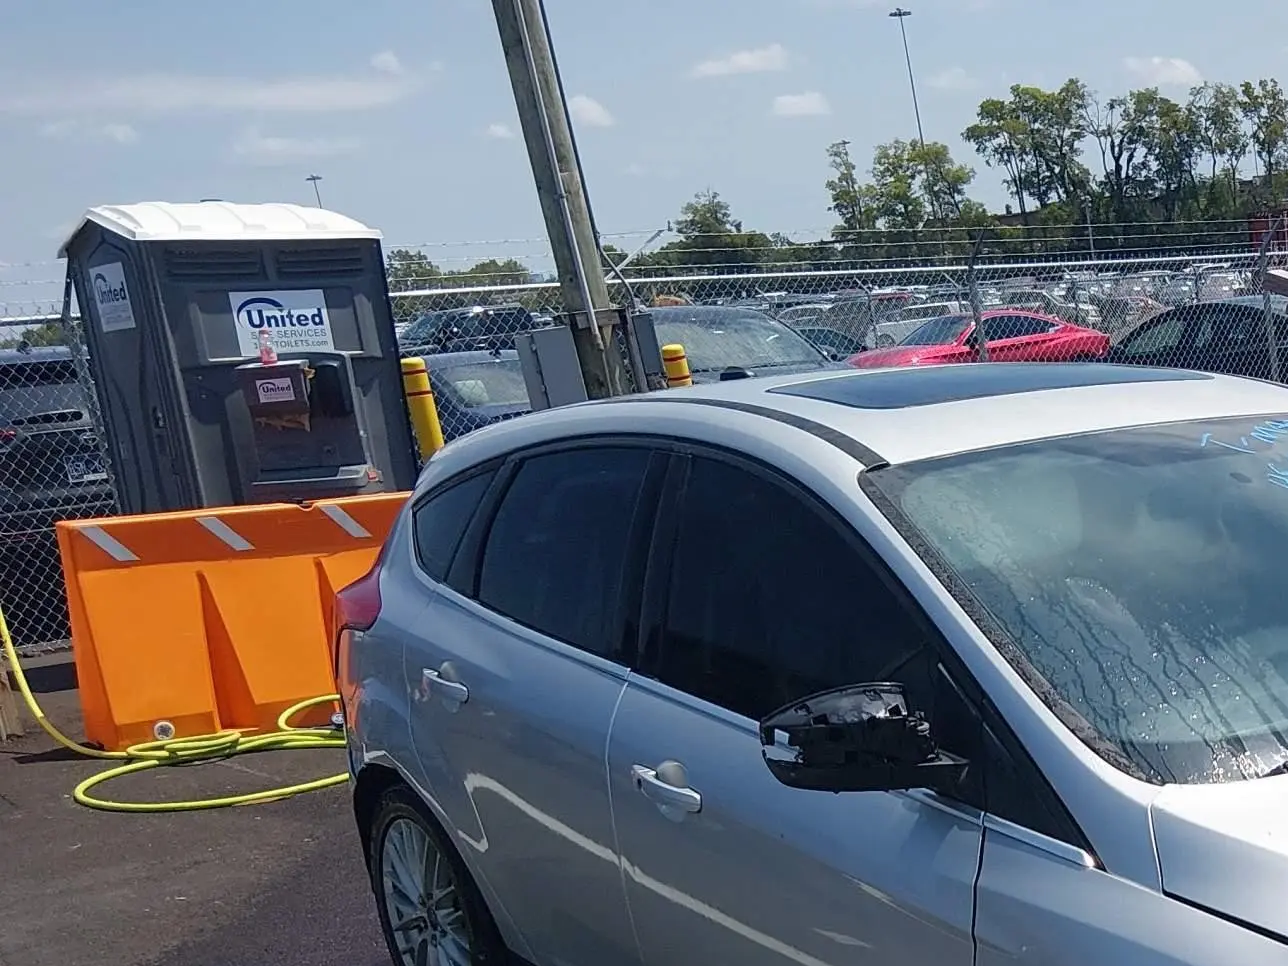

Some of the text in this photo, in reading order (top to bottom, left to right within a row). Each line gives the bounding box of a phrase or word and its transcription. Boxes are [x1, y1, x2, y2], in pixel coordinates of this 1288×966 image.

[97, 281, 127, 304] United
[246, 308, 325, 328] United
[276, 328, 327, 339] SERVICES
[261, 385, 291, 393] United
